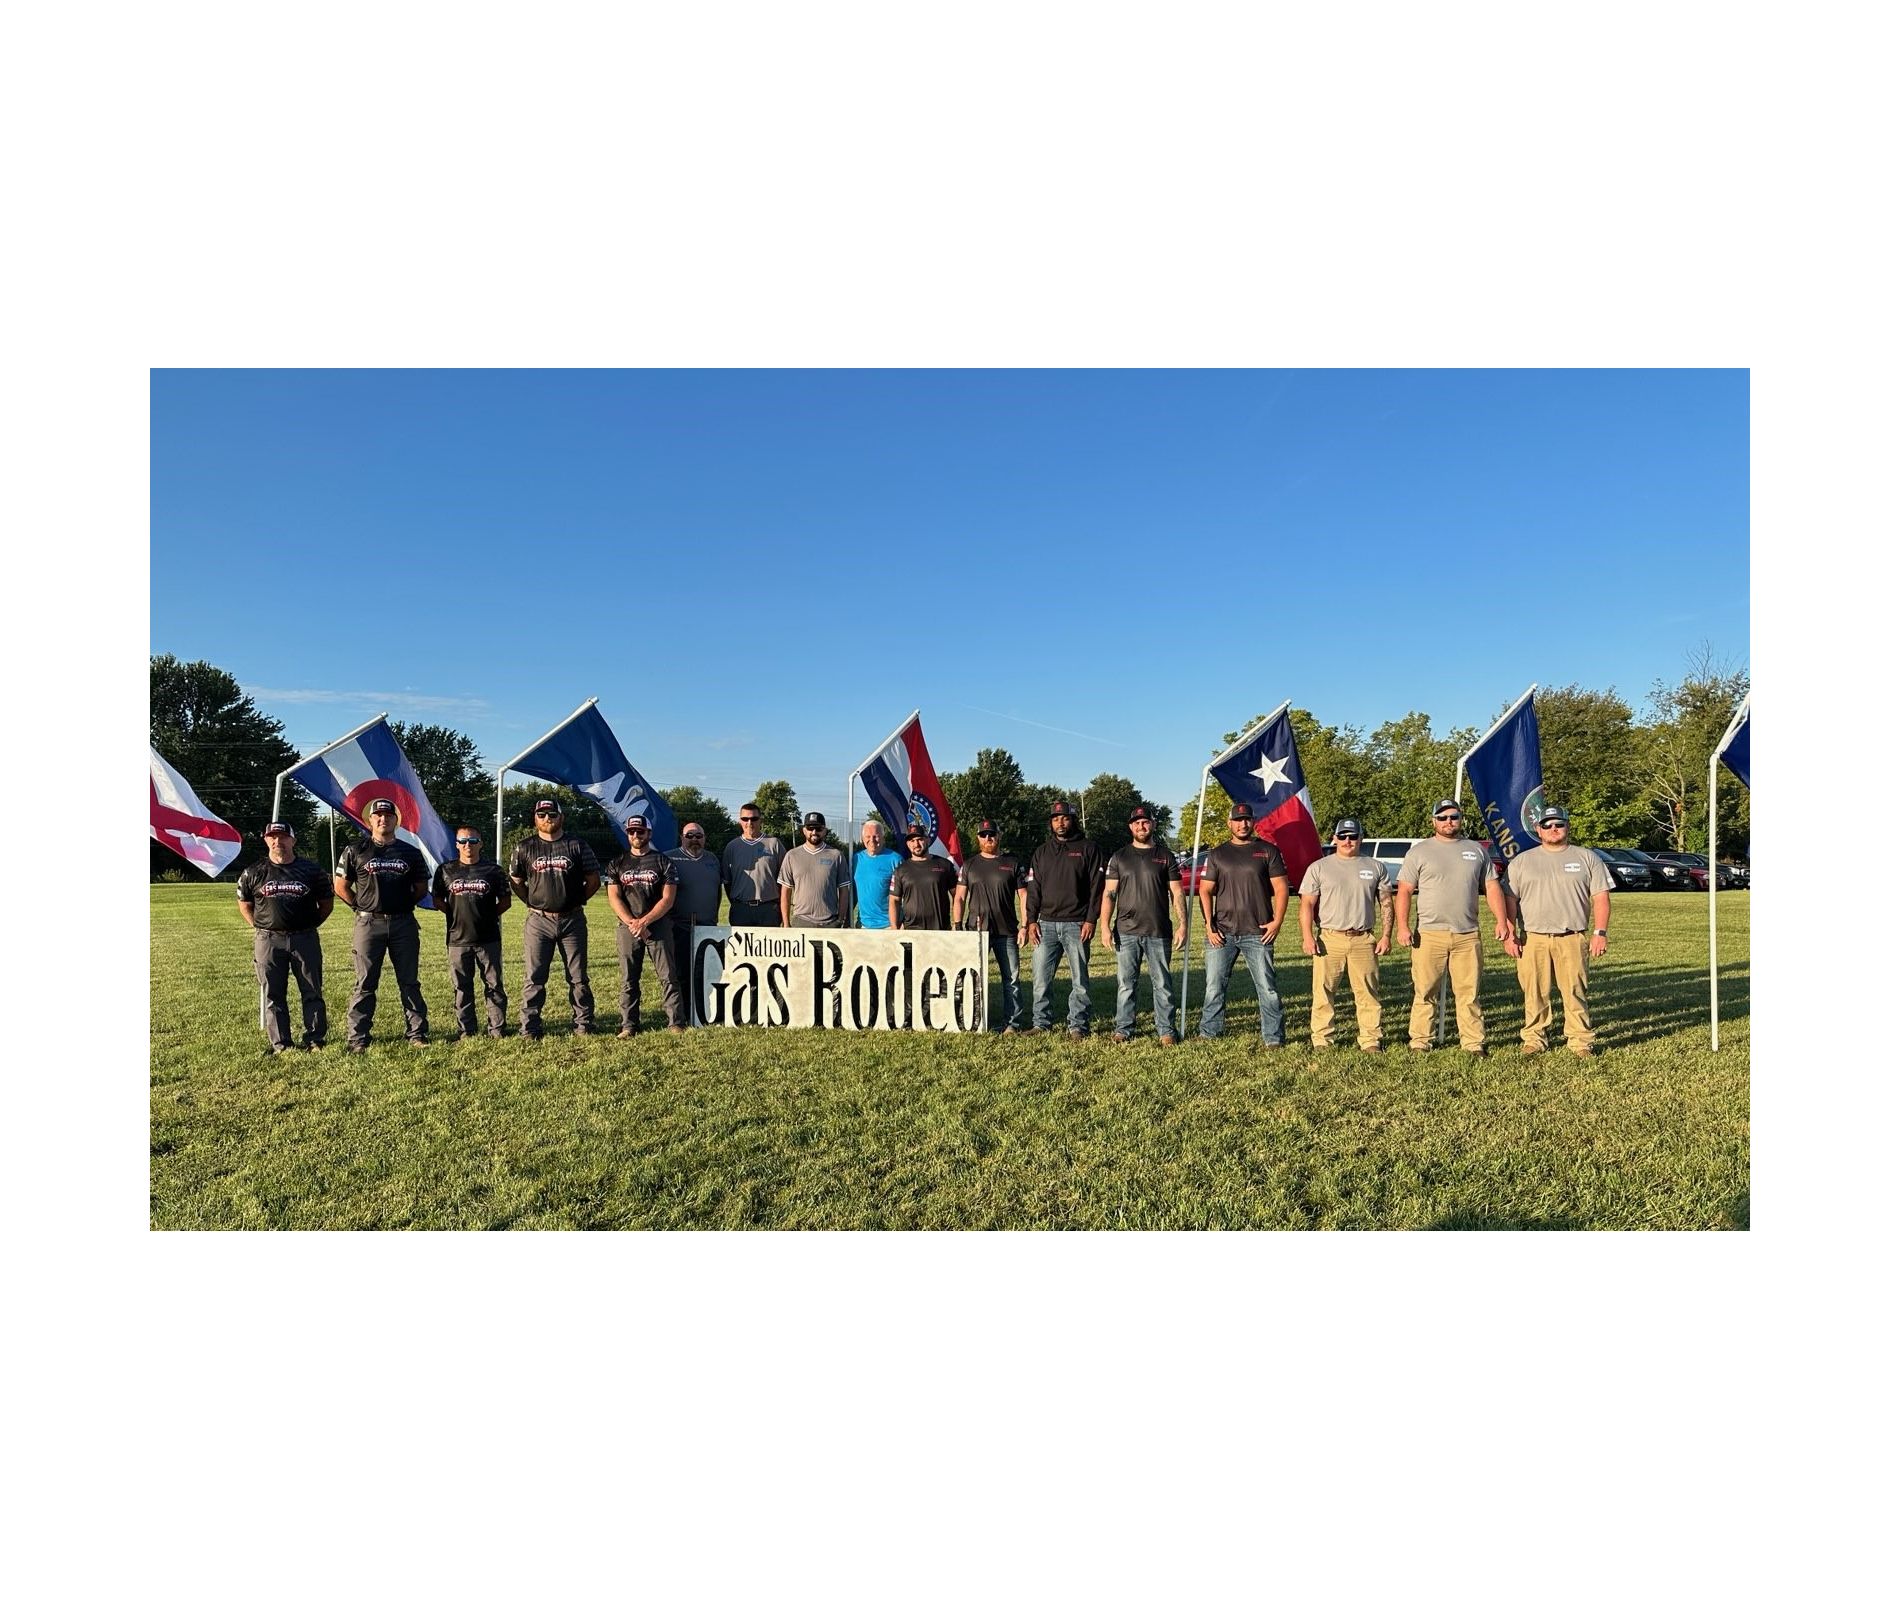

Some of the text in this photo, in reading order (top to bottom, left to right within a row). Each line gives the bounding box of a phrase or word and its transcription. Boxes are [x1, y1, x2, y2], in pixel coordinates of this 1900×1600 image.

[1484, 800, 1521, 860] KANS
[744, 931, 806, 958] National
[694, 938, 983, 1033] Gas Rodeo
